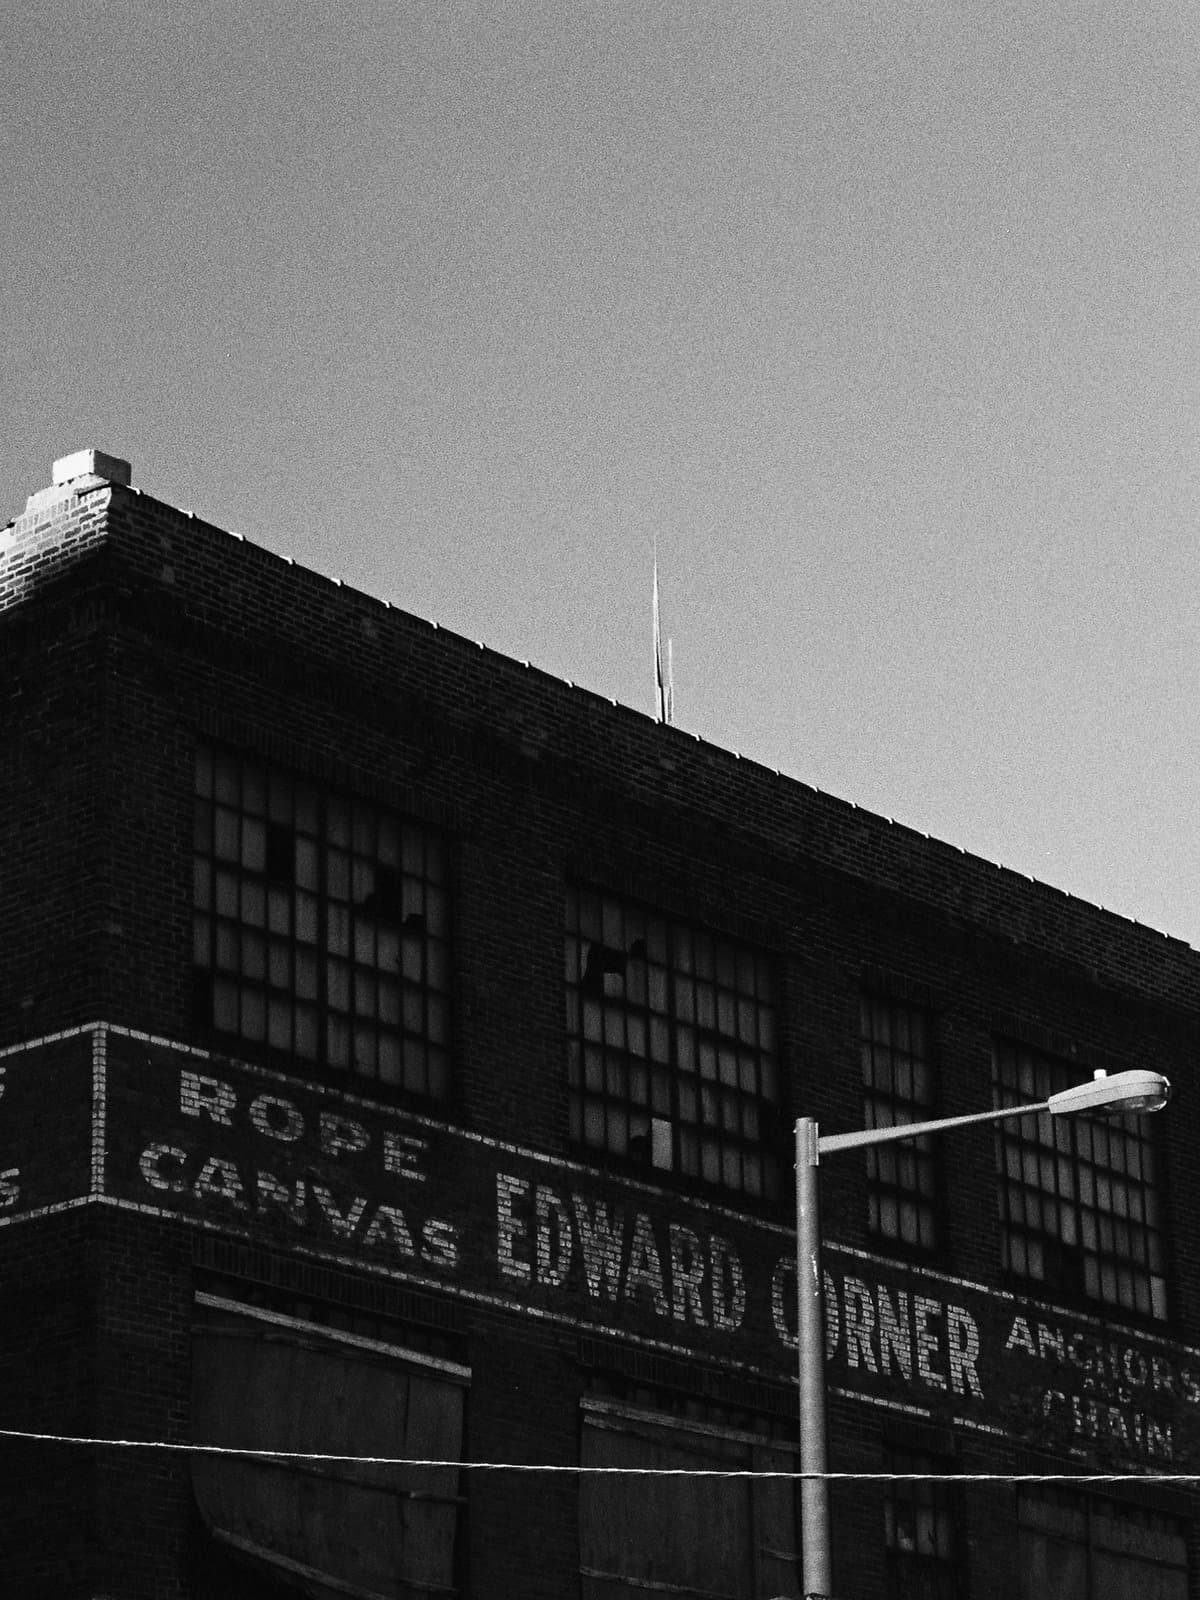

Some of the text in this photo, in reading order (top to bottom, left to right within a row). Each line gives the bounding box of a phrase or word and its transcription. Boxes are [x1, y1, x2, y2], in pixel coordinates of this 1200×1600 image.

[179, 1068, 430, 1184] ROPE
[137, 1142, 460, 1268] CANVAS
[496, 1172, 748, 1333] EDWARD
[1005, 1315, 1200, 1403] ANCHORS
